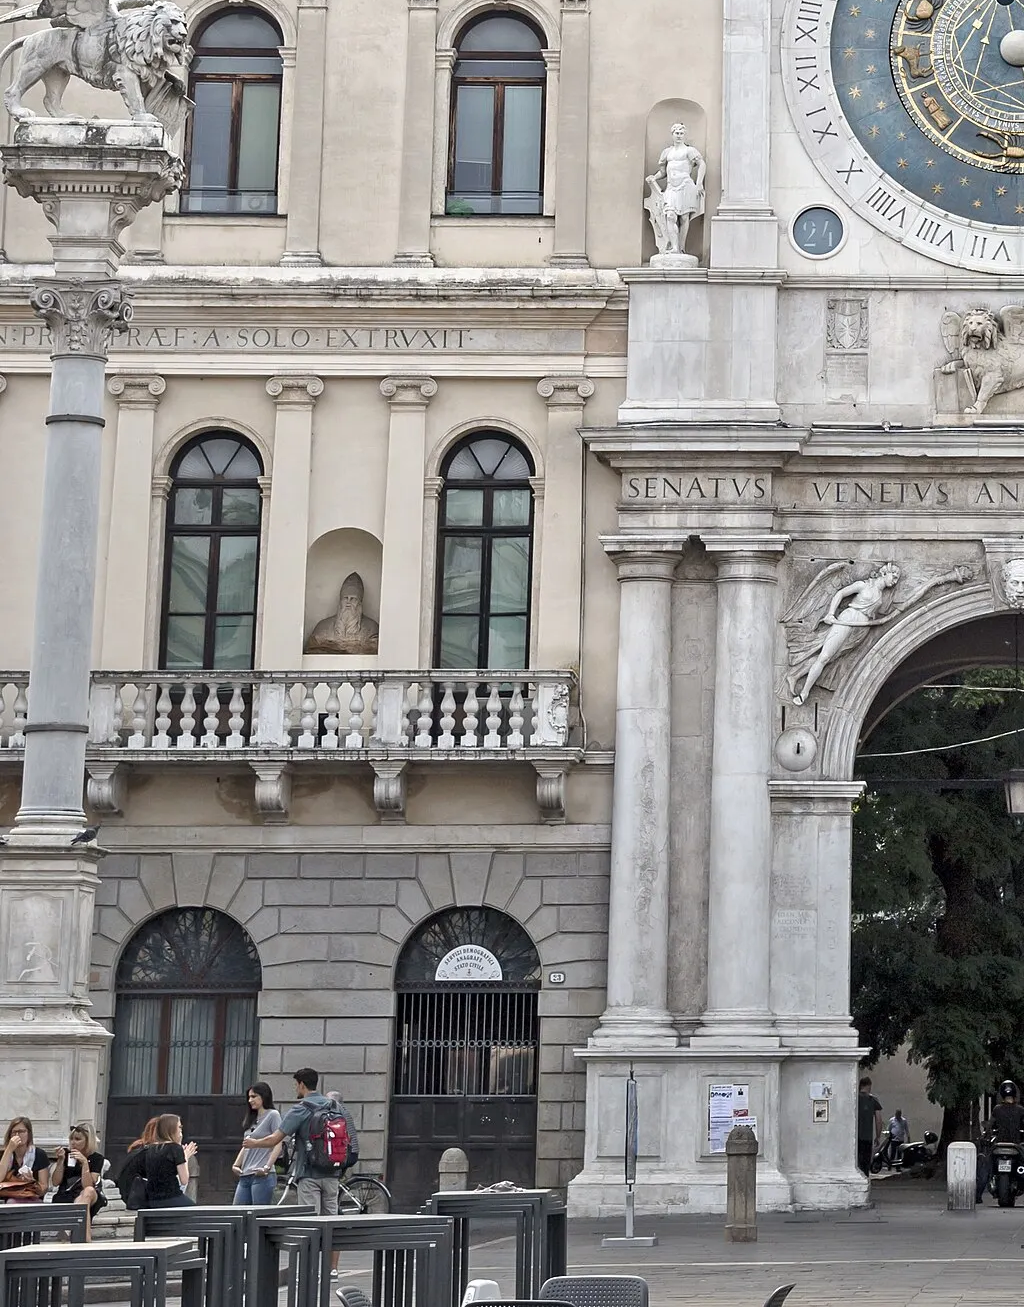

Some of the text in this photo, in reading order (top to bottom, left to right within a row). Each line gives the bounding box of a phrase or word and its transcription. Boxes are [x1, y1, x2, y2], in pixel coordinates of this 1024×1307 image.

[795, 0, 822, 43] XIII
[795, 55, 820, 93] XII
[805, 107, 838, 144] XI
[836, 158, 864, 184] X
[865, 186, 907, 229] VIIII
[803, 219, 833, 247] 24
[916, 218, 955, 251] VIII
[970, 235, 1011, 261] VII
[202, 328, 221, 348] A
[236, 328, 310, 348] SOLO
[326, 328, 468, 349] EXTRVXIT
[628, 476, 766, 500] SENATVS
[813, 481, 949, 504] VENETVS
[445, 948, 494, 966] SERVIZI DEMOGRAFICI
[454, 962, 484, 972] STATO CIVILE
[456, 955, 483, 964] ANAGRAFE
